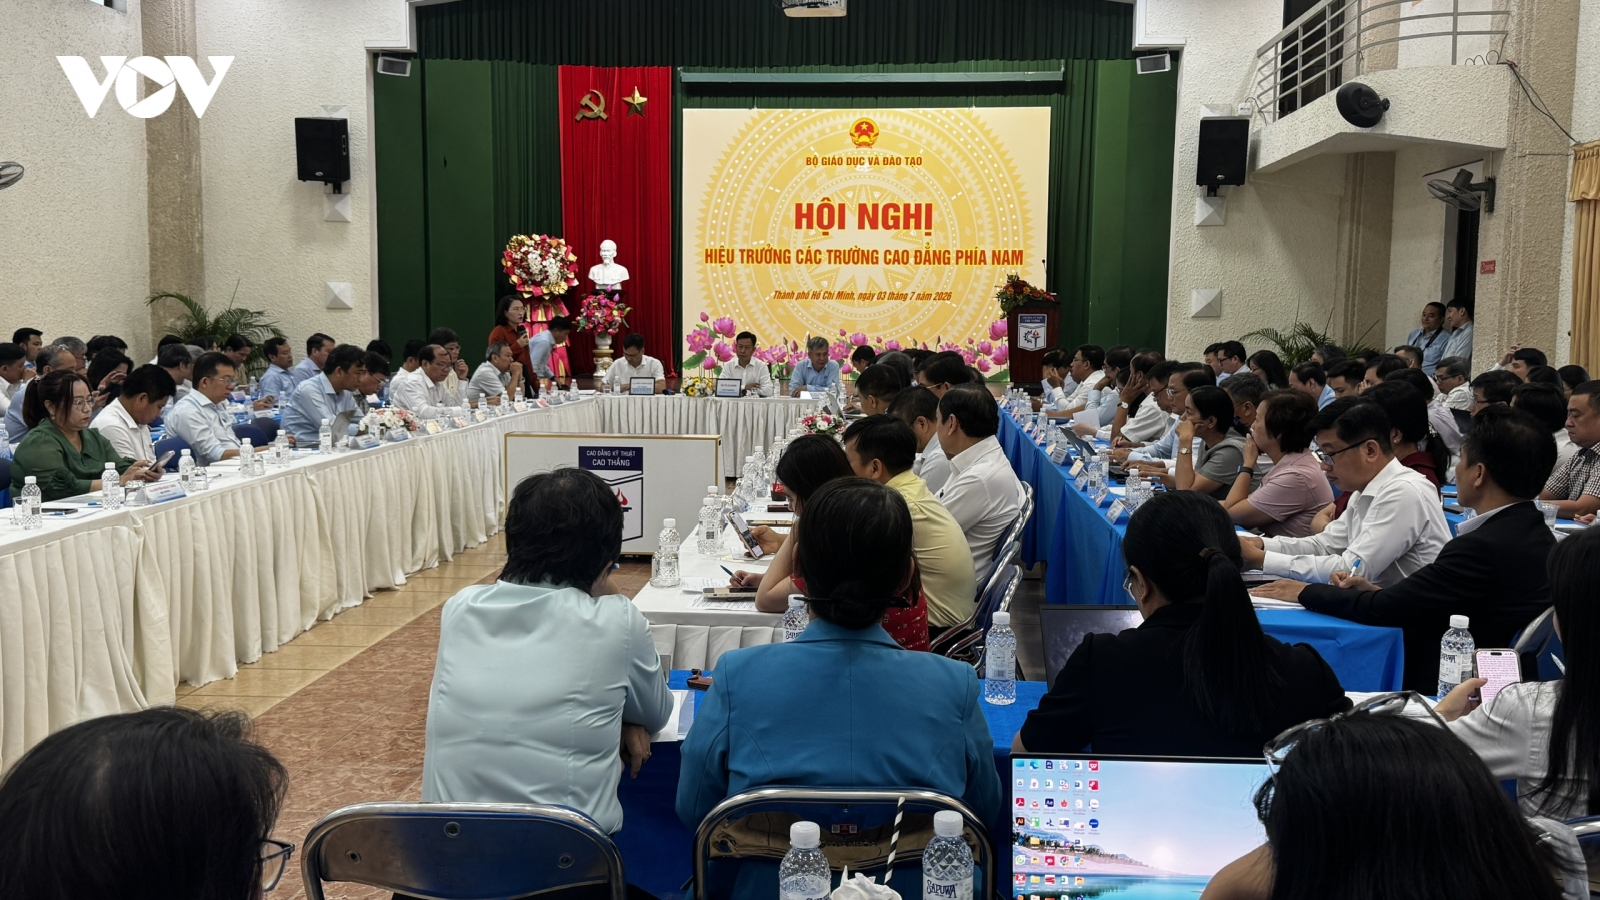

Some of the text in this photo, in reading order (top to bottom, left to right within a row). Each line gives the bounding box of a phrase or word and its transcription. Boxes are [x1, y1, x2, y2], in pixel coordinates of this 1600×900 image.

[806, 155, 923, 168] BỘ GIÁO DỤC VÀ ĐÀO TẠO
[794, 197, 933, 237] HỘI NGHỊ
[705, 242, 1024, 267] HIỆU TRƯỞNG CÁC TRƯỜNG CAO ĐẲNG PHÍA NAM
[773, 290, 795, 300] Thành
[795, 289, 811, 301] phố
[857, 291, 876, 302] ngày
[876, 291, 887, 301] 03
[887, 291, 909, 302] tháng
[909, 291, 916, 301] 7
[915, 291, 933, 301] năm
[933, 291, 953, 301] 2026
[592, 458, 606, 466] CAO
[926, 879, 957, 899] SAPUWA
